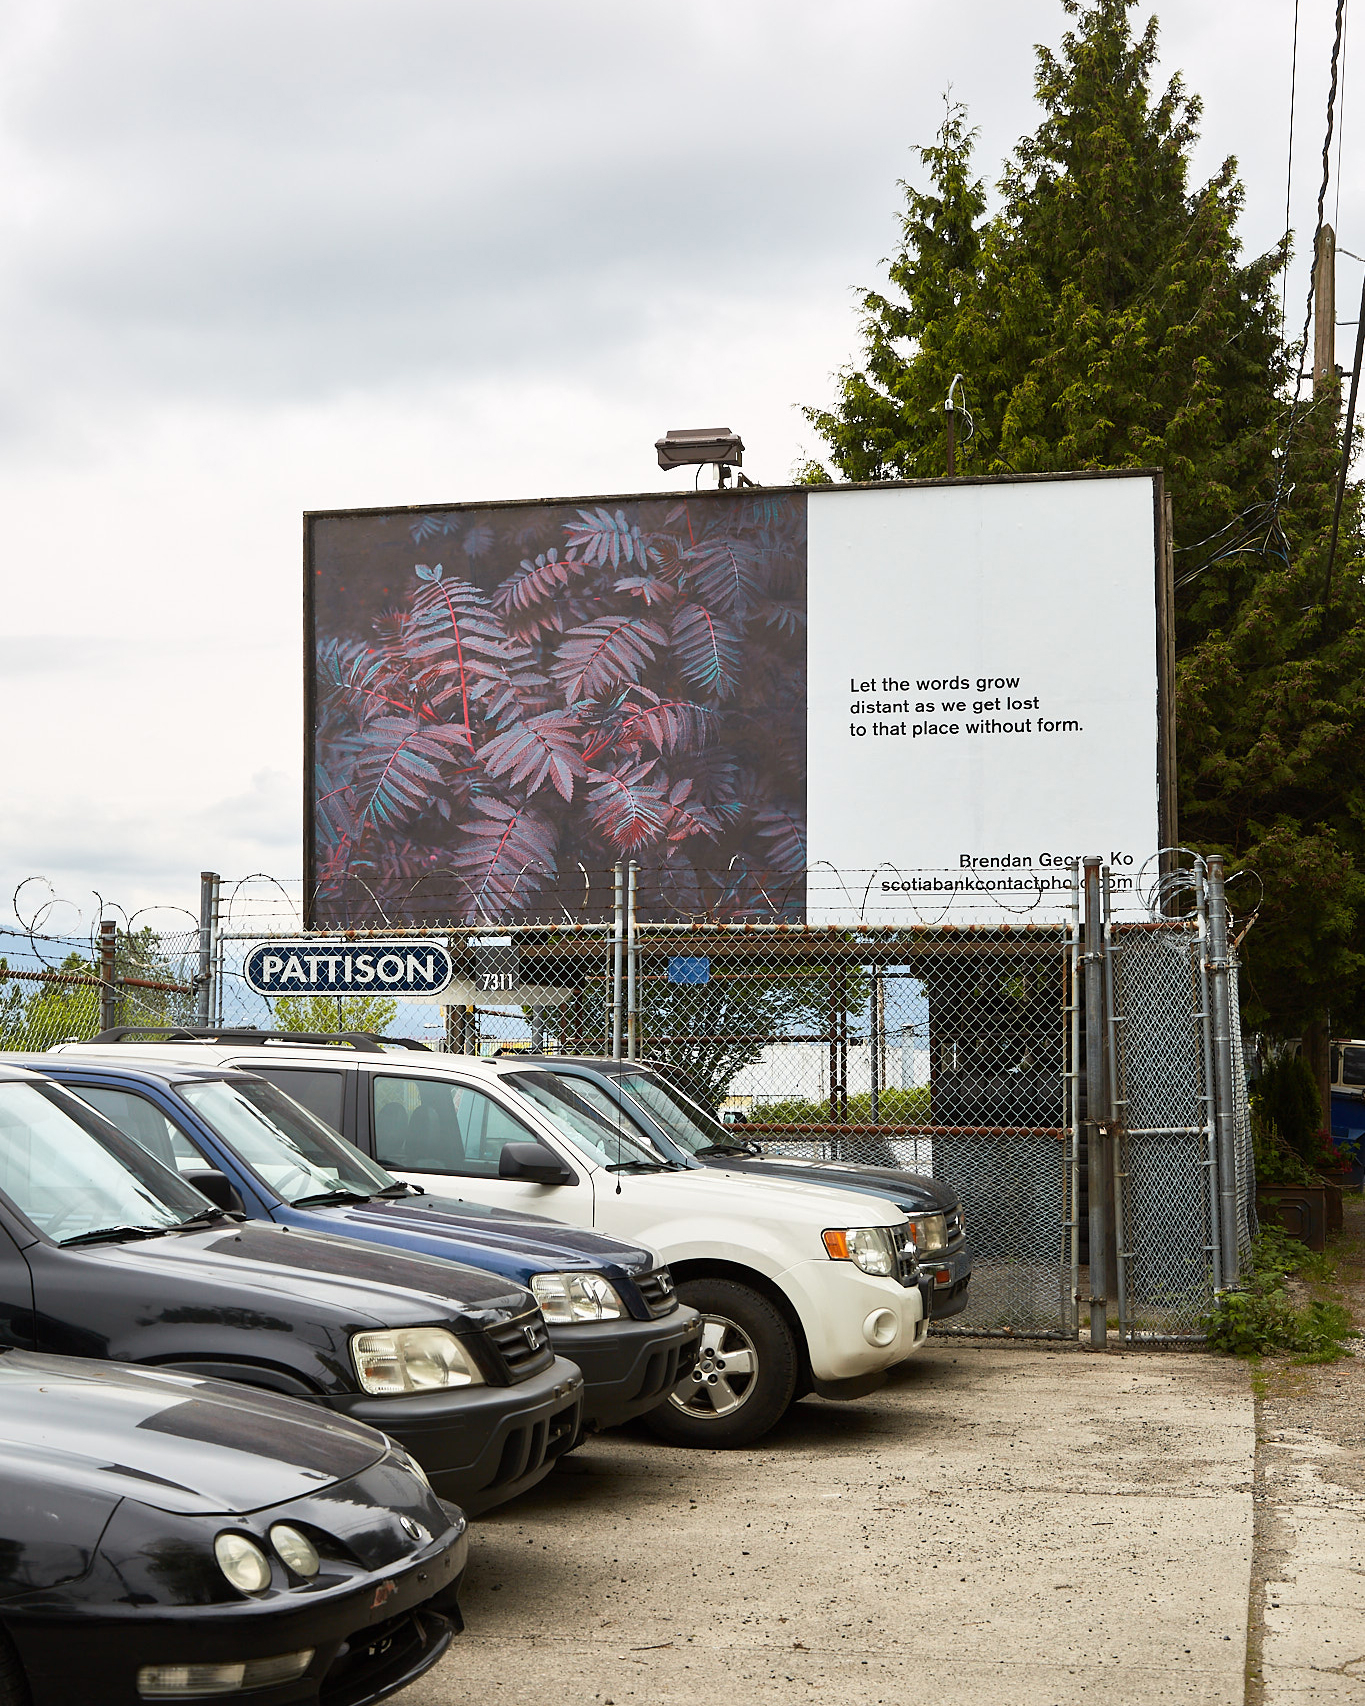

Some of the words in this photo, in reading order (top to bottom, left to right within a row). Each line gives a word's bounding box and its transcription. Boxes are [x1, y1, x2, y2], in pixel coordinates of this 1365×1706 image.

[850, 678, 877, 693] Let
[882, 677, 910, 692] the
[916, 675, 970, 691] words
[976, 677, 1020, 692] grow
[850, 699, 910, 714] distant
[914, 701, 936, 713] as
[941, 701, 967, 712] we
[972, 697, 1001, 714] get
[1007, 696, 1040, 710] lost
[849, 722, 867, 737] to
[872, 721, 907, 736] that
[912, 720, 960, 738] place
[965, 718, 1032, 734] without
[1037, 717, 1084, 732] form.
[960, 853, 1032, 868] Brendan
[1110, 851, 1134, 866] Ko
[262, 954, 434, 984] PATTISON
[482, 973, 513, 991] 7311
